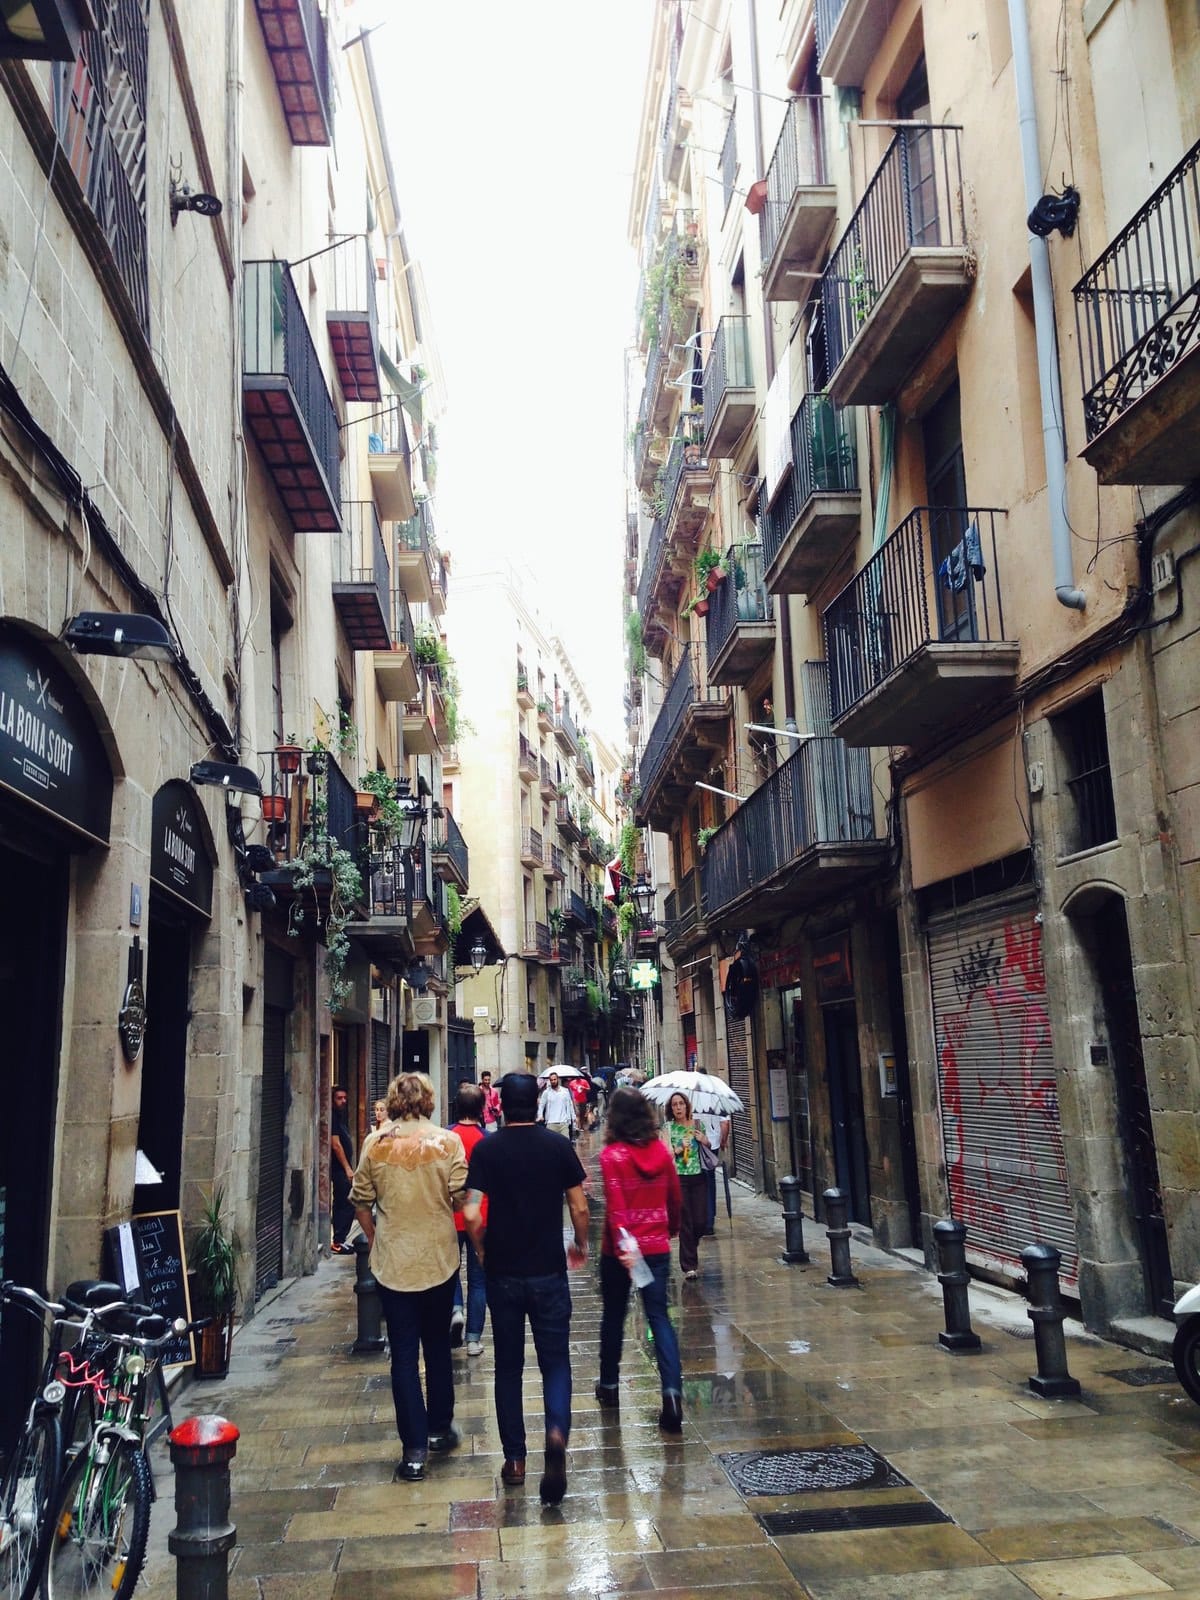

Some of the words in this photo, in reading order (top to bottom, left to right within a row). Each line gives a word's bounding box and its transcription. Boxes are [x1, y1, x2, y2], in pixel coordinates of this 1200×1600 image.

[0, 692, 14, 737] LA
[16, 704, 45, 759] BONA
[47, 729, 74, 777] SORT
